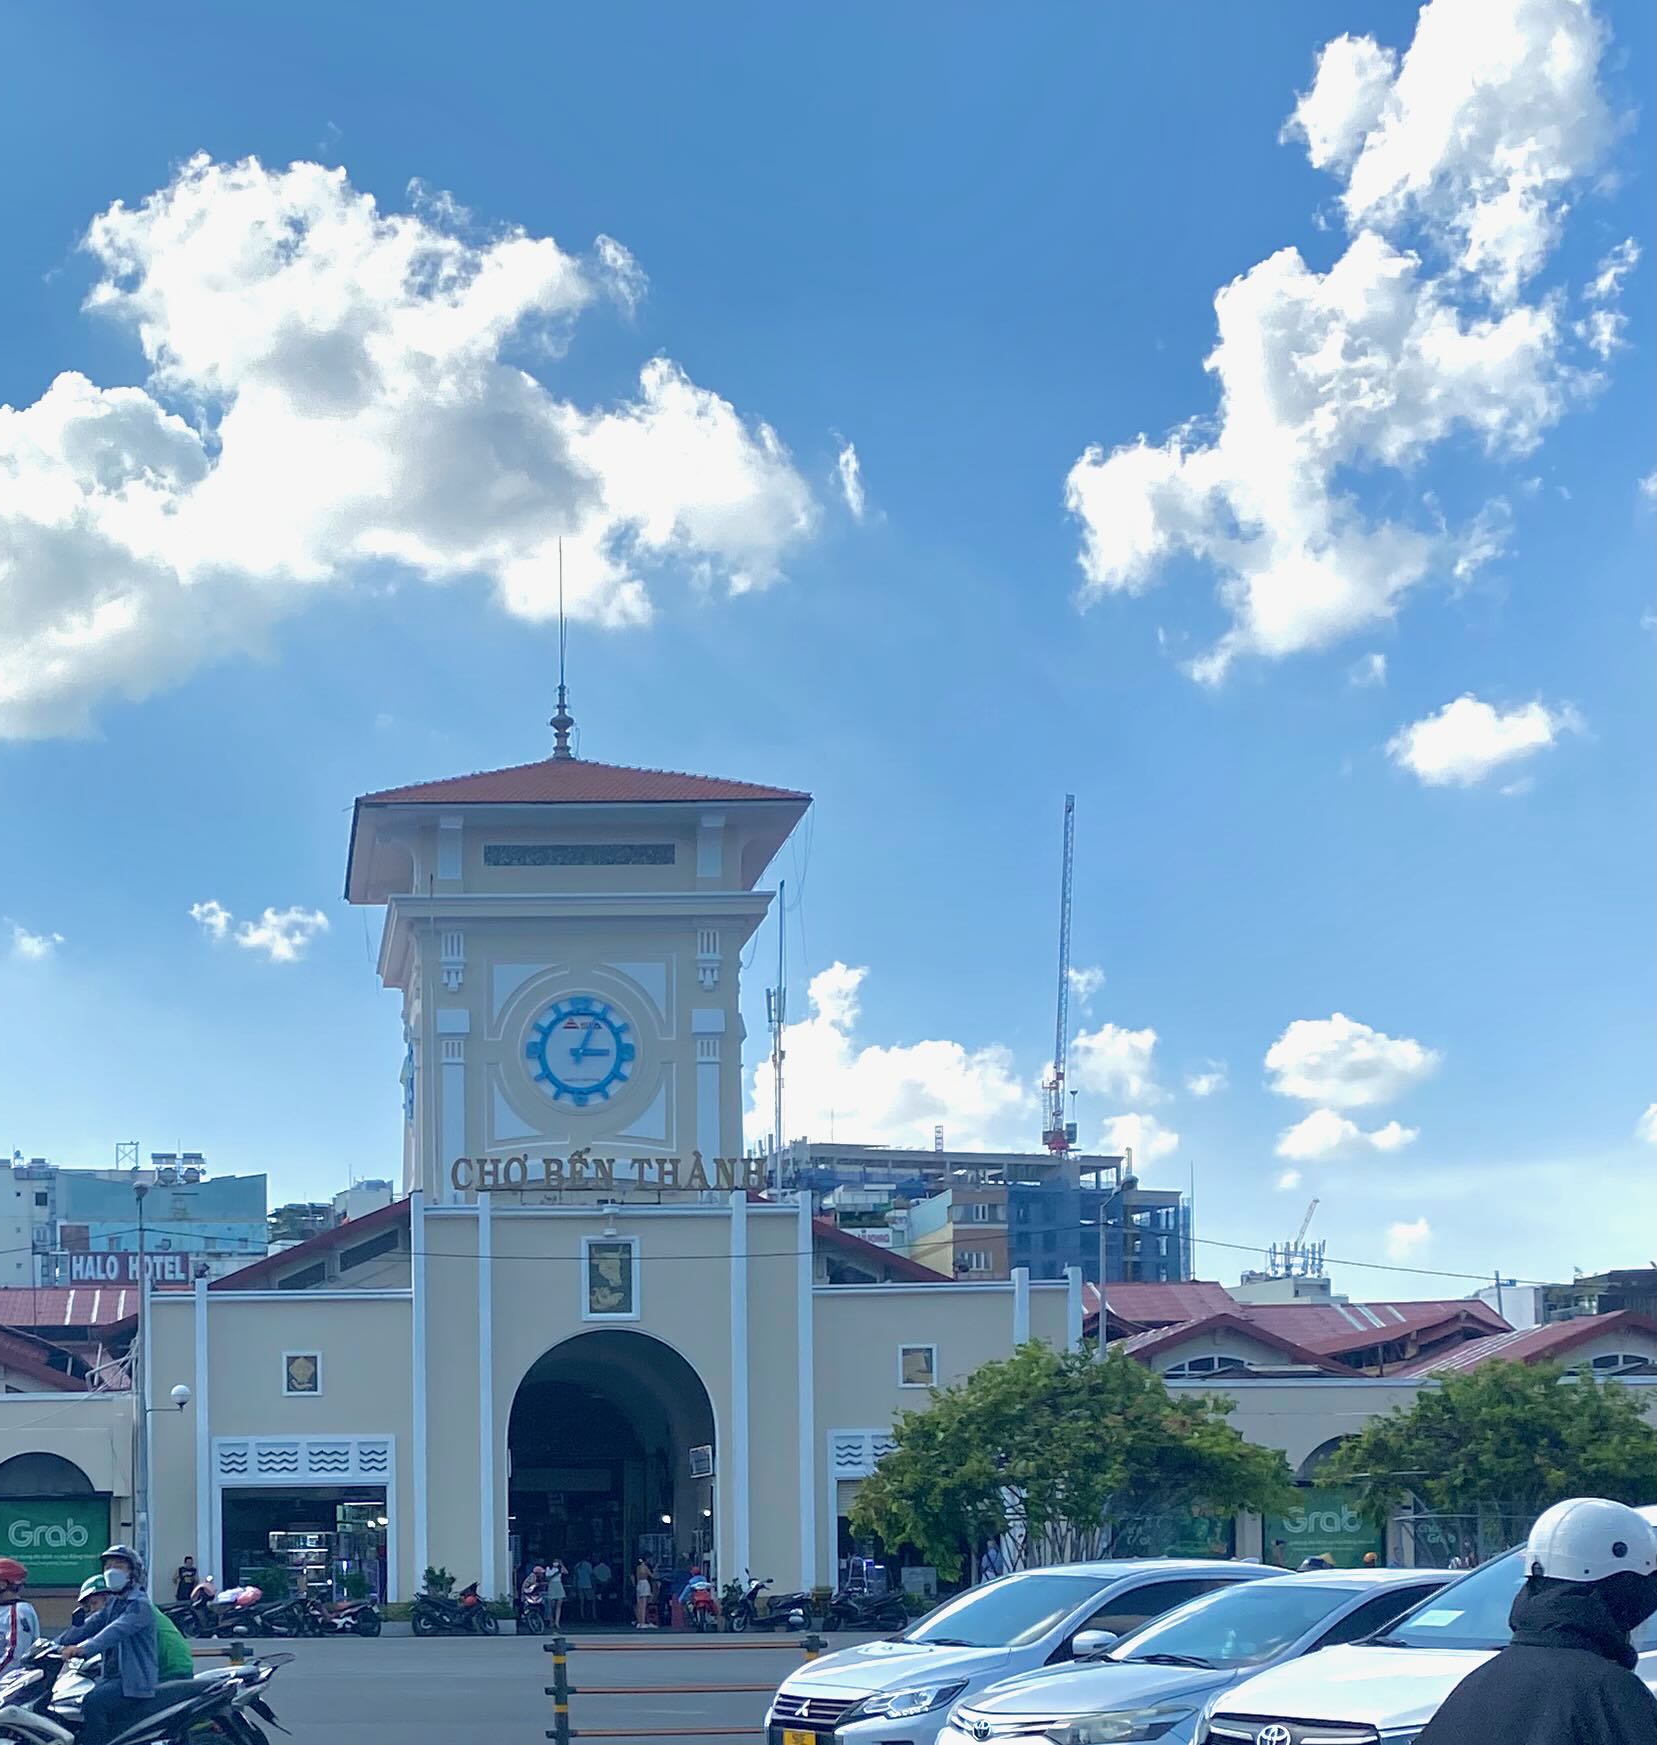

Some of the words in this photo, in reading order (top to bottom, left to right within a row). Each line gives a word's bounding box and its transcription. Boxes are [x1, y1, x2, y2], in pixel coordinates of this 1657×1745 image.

[629, 1150, 769, 1191] THÀNH
[72, 1255, 120, 1281] HALO
[8, 1517, 89, 1548] Grab
[1283, 1504, 1363, 1534] Grab
